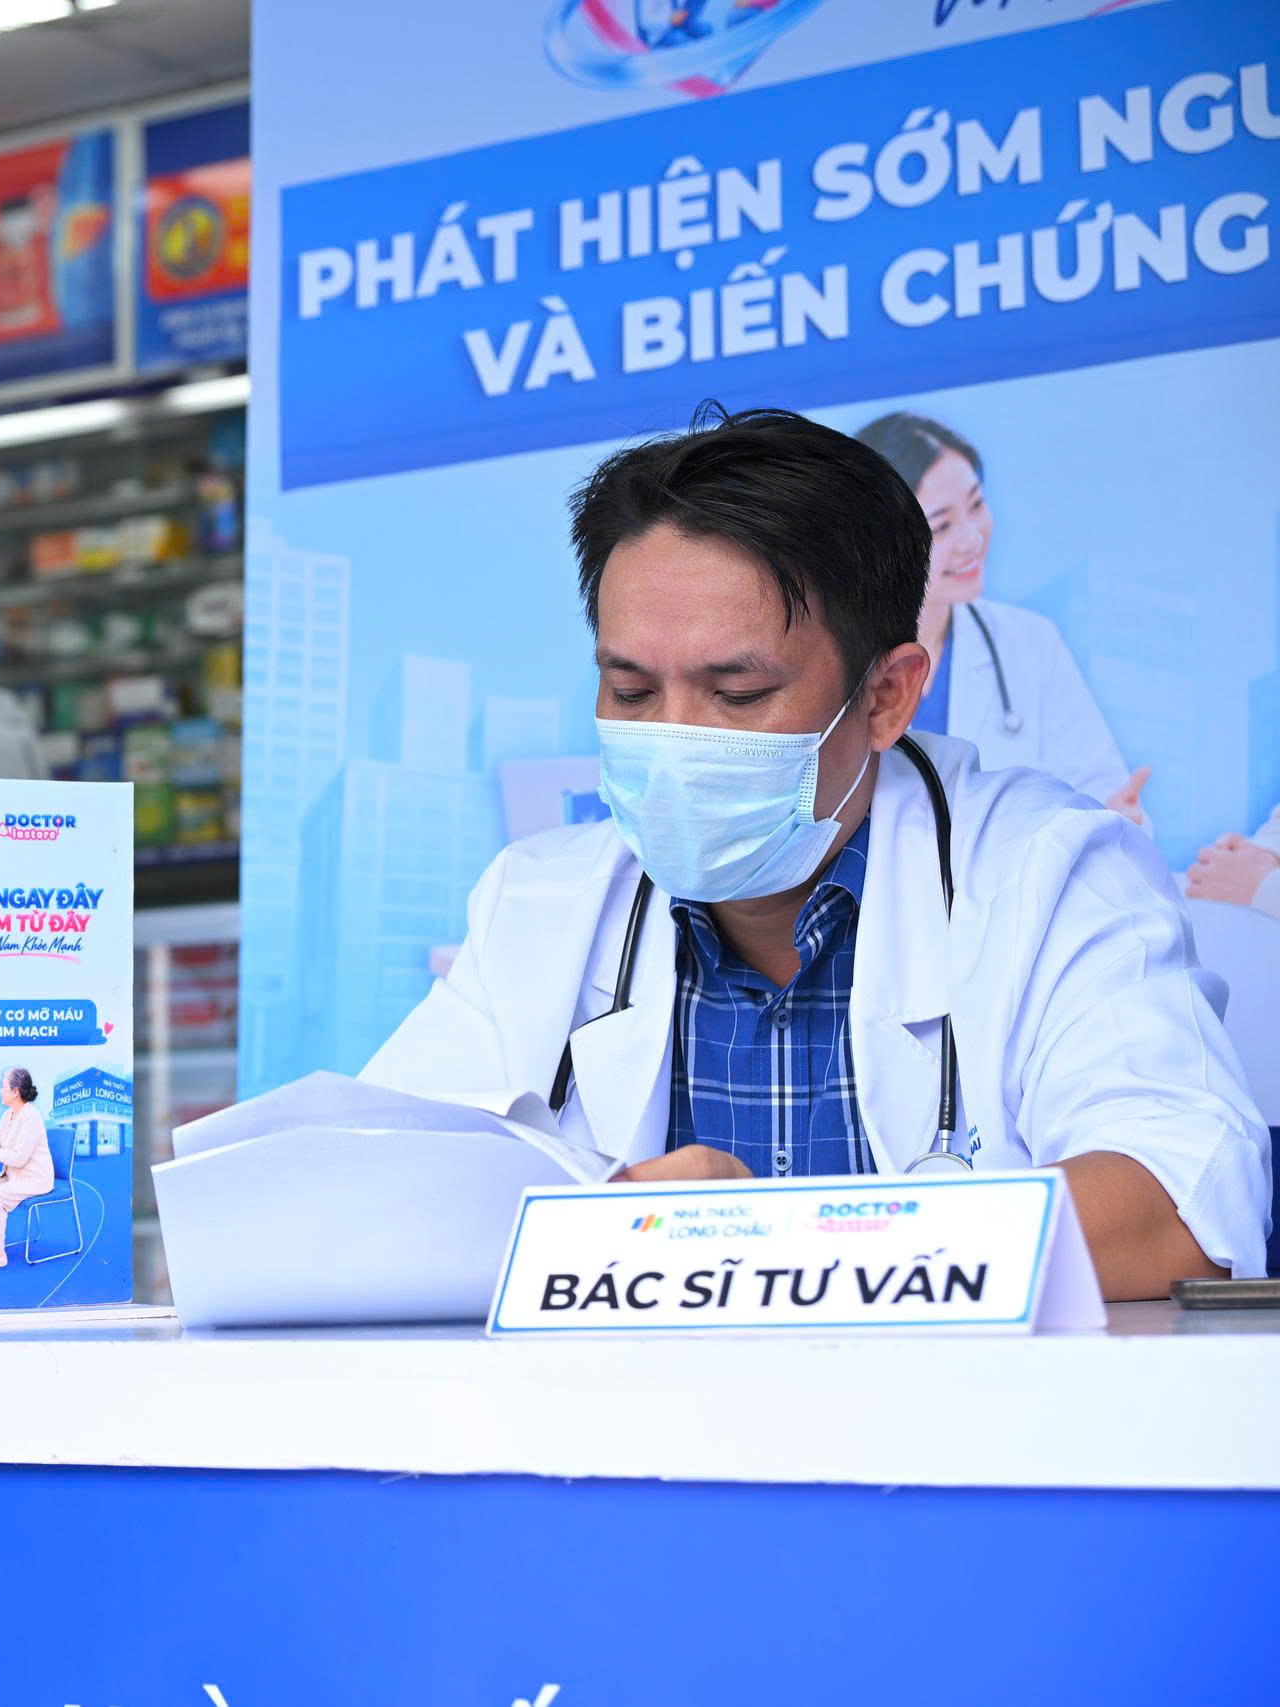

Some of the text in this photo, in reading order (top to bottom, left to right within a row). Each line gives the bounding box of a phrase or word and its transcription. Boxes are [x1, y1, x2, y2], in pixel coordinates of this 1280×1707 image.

[299, 201, 533, 319] PHÁT
[559, 154, 782, 270] HIỆN
[812, 105, 1042, 221] SỚM
[463, 192, 1270, 397] VÀ BIẾN CHỨNG
[725, 745, 784, 758] DANAMECO
[5, 814, 76, 828] DOCTOR
[55, 882, 104, 909] ĐÂY
[16, 909, 47, 933] TỪ
[48, 910, 91, 933] ĐÂY
[48, 935, 83, 954] Mạnh
[5, 1007, 25, 1021] CƠ
[28, 1006, 50, 1021] MỠ
[53, 1006, 84, 1021] MÁU
[17, 1025, 58, 1040] MẠCH
[54, 1095, 71, 1108] LONG
[95, 1087, 115, 1100] LONG
[819, 1200, 919, 1218] DOCTOR
[539, 1247, 988, 1311] BÁC SĨ TƯ VẤN
